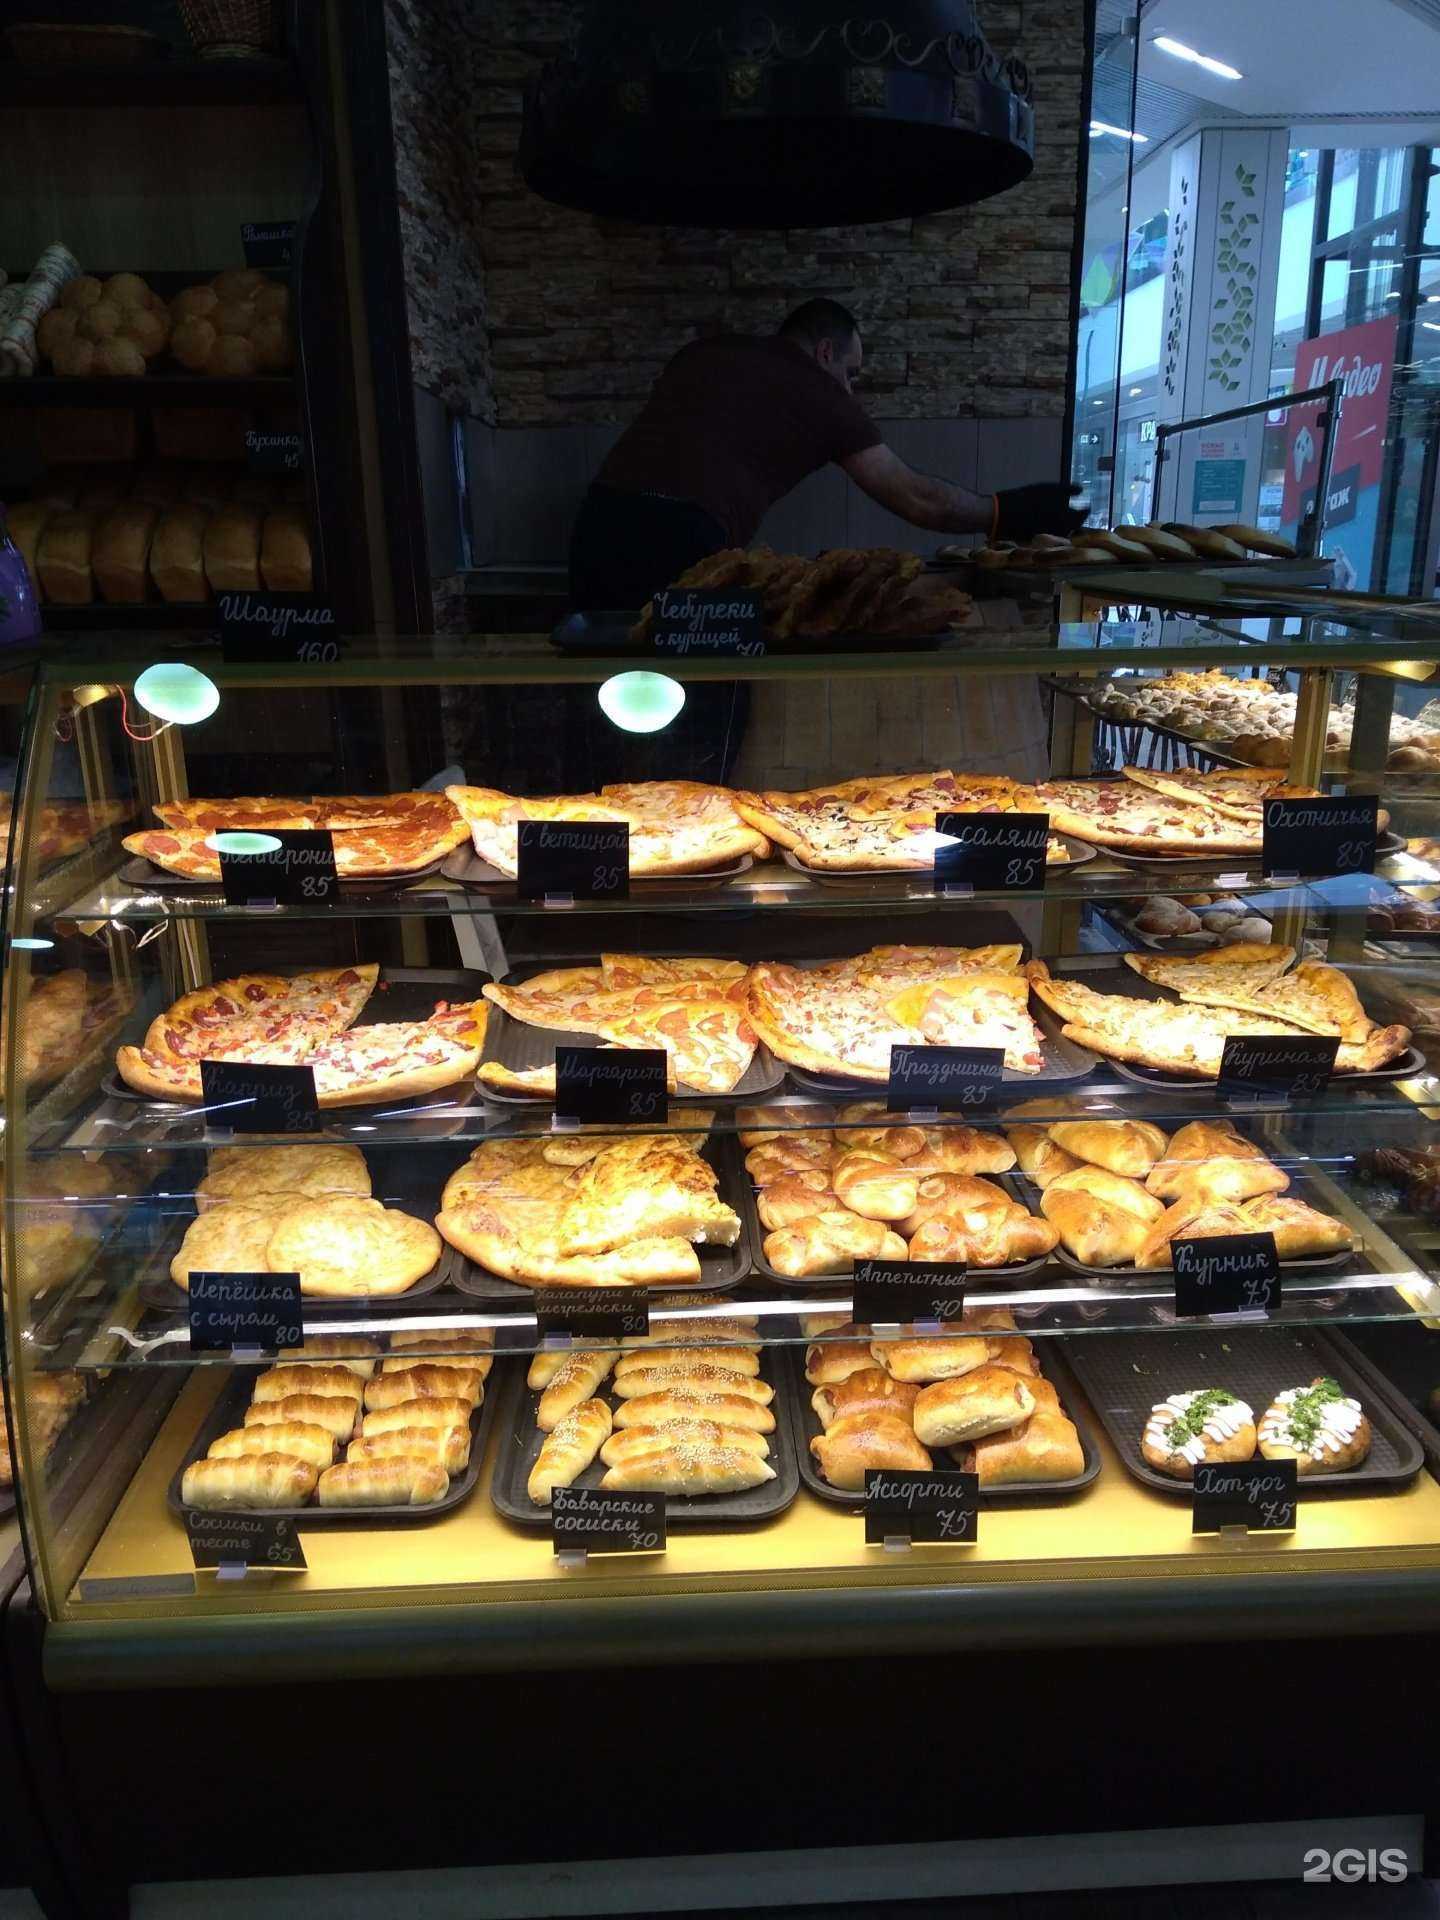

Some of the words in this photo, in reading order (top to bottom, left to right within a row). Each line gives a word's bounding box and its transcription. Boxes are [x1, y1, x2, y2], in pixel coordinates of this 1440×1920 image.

[219, 596, 335, 637] Шаурма
[654, 592, 756, 631] Чебуреки
[296, 642, 338, 664] 160
[655, 634, 664, 645] с
[667, 629, 740, 652] курицей
[1267, 801, 1374, 828] Охотничья
[521, 824, 533, 847] С
[540, 824, 628, 850] ветчиной
[961, 825, 1048, 849] салями
[1335, 840, 1373, 867] 85
[592, 866, 625, 890] 85
[1005, 858, 1042, 885] 85
[301, 876, 333, 896] 85
[559, 1055, 667, 1087] Маргарита
[890, 1049, 1003, 1083] Празднична
[1225, 1042, 1331, 1077] Куриная
[629, 1092, 662, 1115] 85
[961, 1085, 994, 1105] 85
[856, 1261, 967, 1286] Аппетитный
[1176, 1245, 1269, 1285] Курник
[191, 1274, 295, 1301] Лепёшка
[536, 1288, 624, 1303] Хачапури
[1242, 1276, 1276, 1306] 75
[931, 1299, 960, 1317] 70
[191, 1314, 201, 1327] с
[208, 1311, 279, 1334] сыром
[275, 1326, 299, 1344] 80
[622, 1315, 646, 1331] 80
[866, 1474, 965, 1509] Ассорти
[1195, 1468, 1286, 1503] Хот-дог
[553, 1488, 655, 1518] Баварские
[1260, 1502, 1294, 1527] 75
[190, 1513, 264, 1532] Сосиски
[274, 1520, 288, 1536] в
[554, 1516, 640, 1531] сосиски
[936, 1509, 975, 1536] 75
[190, 1537, 252, 1550] тесте
[267, 1542, 296, 1561] 65
[628, 1531, 659, 1549] 70
